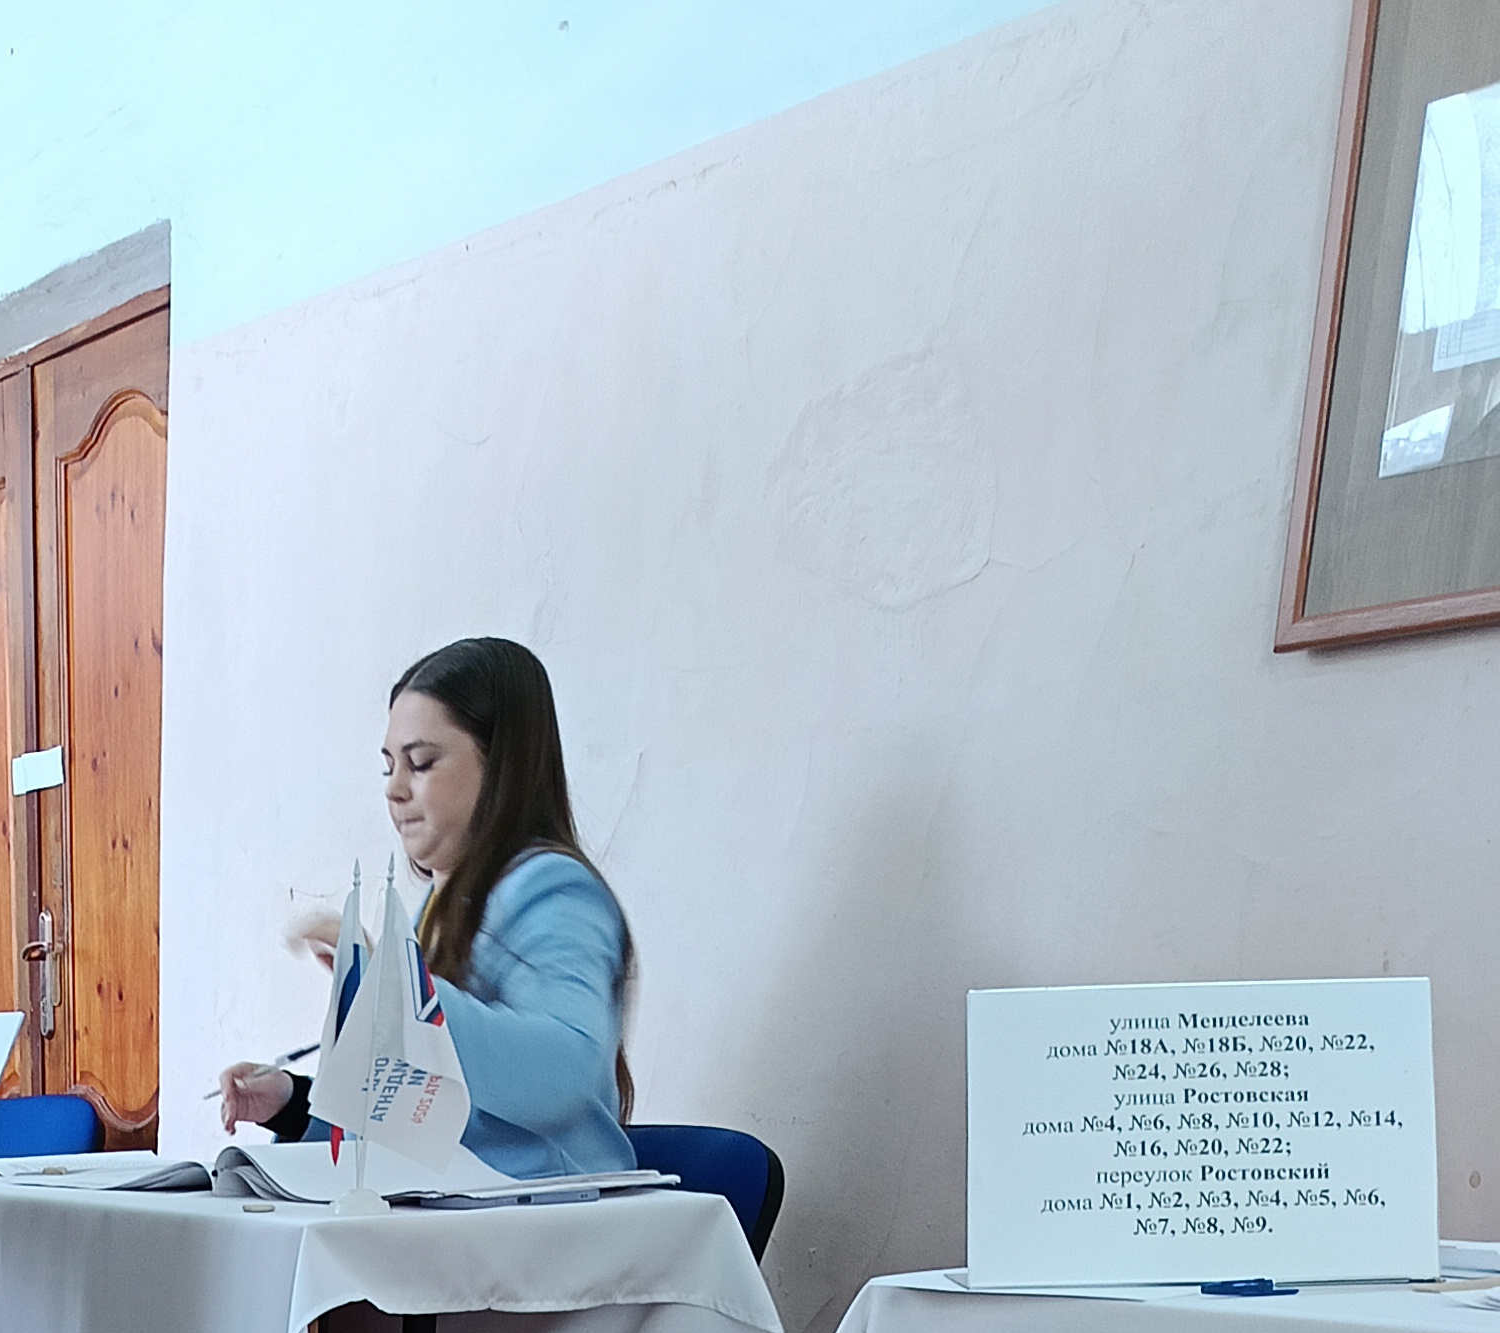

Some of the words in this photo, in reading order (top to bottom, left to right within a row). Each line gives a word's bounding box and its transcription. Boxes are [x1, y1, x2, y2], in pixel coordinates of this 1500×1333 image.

[1109, 1016, 1171, 1034] улица
[1178, 1012, 1310, 1030] Менделеева
[1045, 1044, 1098, 1061] дома
[1103, 1037, 1176, 1057] №18А,
[1181, 1035, 1254, 1056] №18Б,
[1258, 1034, 1314, 1054] №20,
[1319, 1033, 1375, 1054] №22,
[1111, 1062, 1167, 1083] №24,
[1172, 1061, 1228, 1081] №26,
[1232, 1060, 1290, 1081] №28;
[1113, 1092, 1176, 1111] улица
[1183, 1087, 1309, 1105] Ростовская
[1021, 1120, 1074, 1137] дома
[1079, 1114, 1123, 1135] №4,
[1127, 1113, 1171, 1134] №6,
[1176, 1112, 1220, 1133] №8,
[1224, 1111, 1281, 1132] №10,
[1286, 1110, 1342, 1131] №12,
[1347, 1109, 1403, 1130] №14,
[1112, 1139, 1169, 1160] №16,
[1173, 1137, 1229, 1159] №20,
[1234, 1136, 1292, 1158] №22;
[1096, 1169, 1193, 1188] переулок
[1200, 1162, 1330, 1182] Ростовский
[1040, 1197, 1093, 1214] дома
[1098, 1191, 1142, 1213] №1,
[1147, 1190, 1191, 1212] №2,
[1195, 1190, 1239, 1211] №3,
[1244, 1189, 1289, 1210] №4,
[1293, 1188, 1337, 1209] №5,
[1342, 1187, 1386, 1209] №6,
[1132, 1217, 1176, 1238] №7,
[1181, 1216, 1225, 1238] №8,
[1230, 1215, 1274, 1234] №9.
